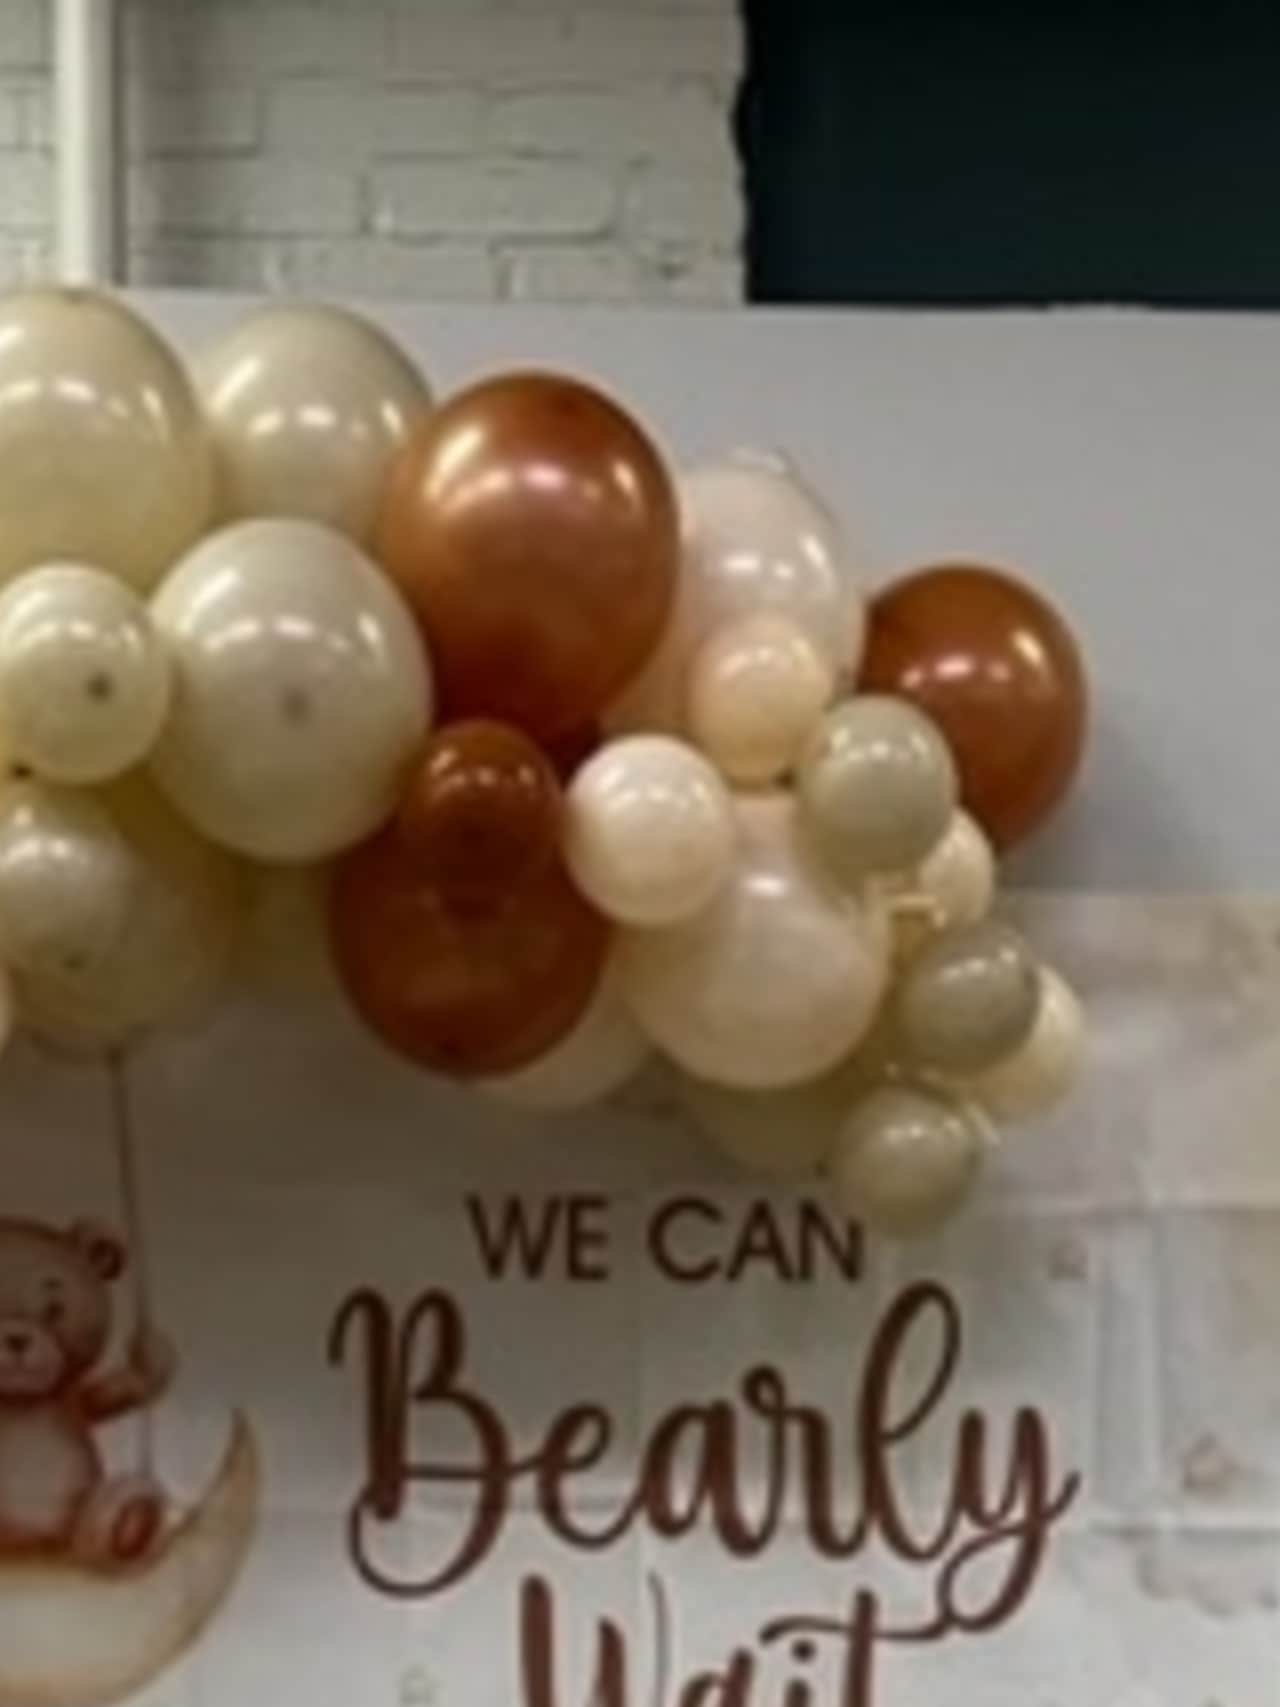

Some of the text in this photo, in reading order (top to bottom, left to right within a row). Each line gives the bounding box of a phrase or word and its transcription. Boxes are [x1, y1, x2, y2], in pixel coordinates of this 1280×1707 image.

[464, 1193, 866, 1285] WE CAN
[327, 1280, 1083, 1635] Bearly
